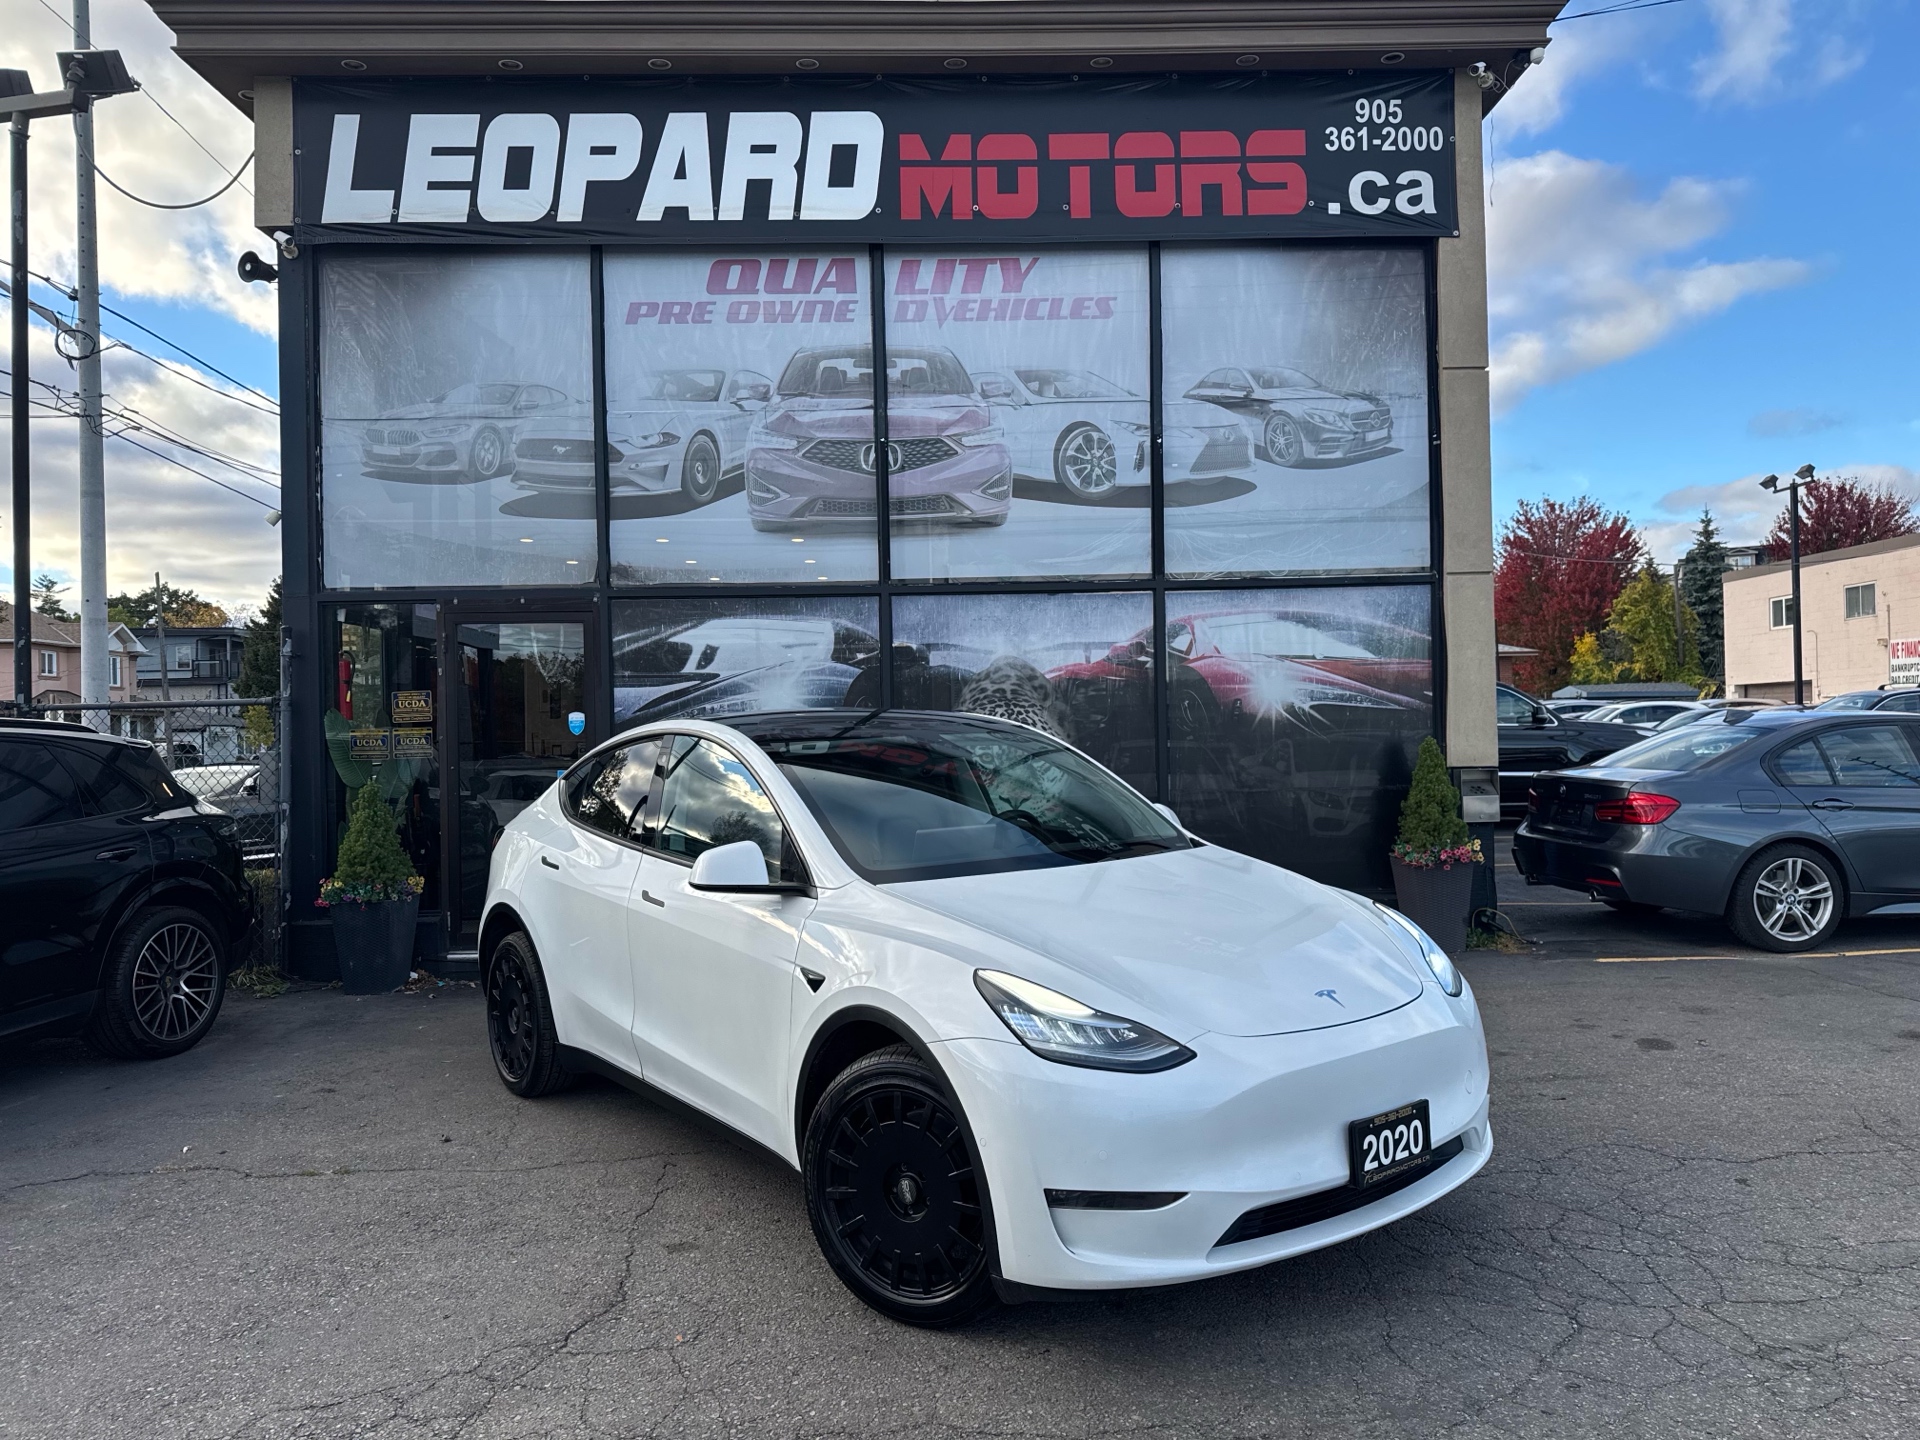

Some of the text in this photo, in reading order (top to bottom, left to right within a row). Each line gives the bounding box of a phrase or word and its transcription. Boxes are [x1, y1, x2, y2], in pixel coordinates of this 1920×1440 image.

[1354, 98, 1402, 124] 905
[1324, 126, 1444, 152] 361-2000
[321, 111, 1307, 223] LEOPARD MOTORS
[1327, 168, 1437, 216] .ca
[624, 300, 715, 326] PRE
[1891, 642, 1899, 659] WE
[398, 700, 425, 708] UCDA
[1363, 1119, 1423, 1172] 2020
